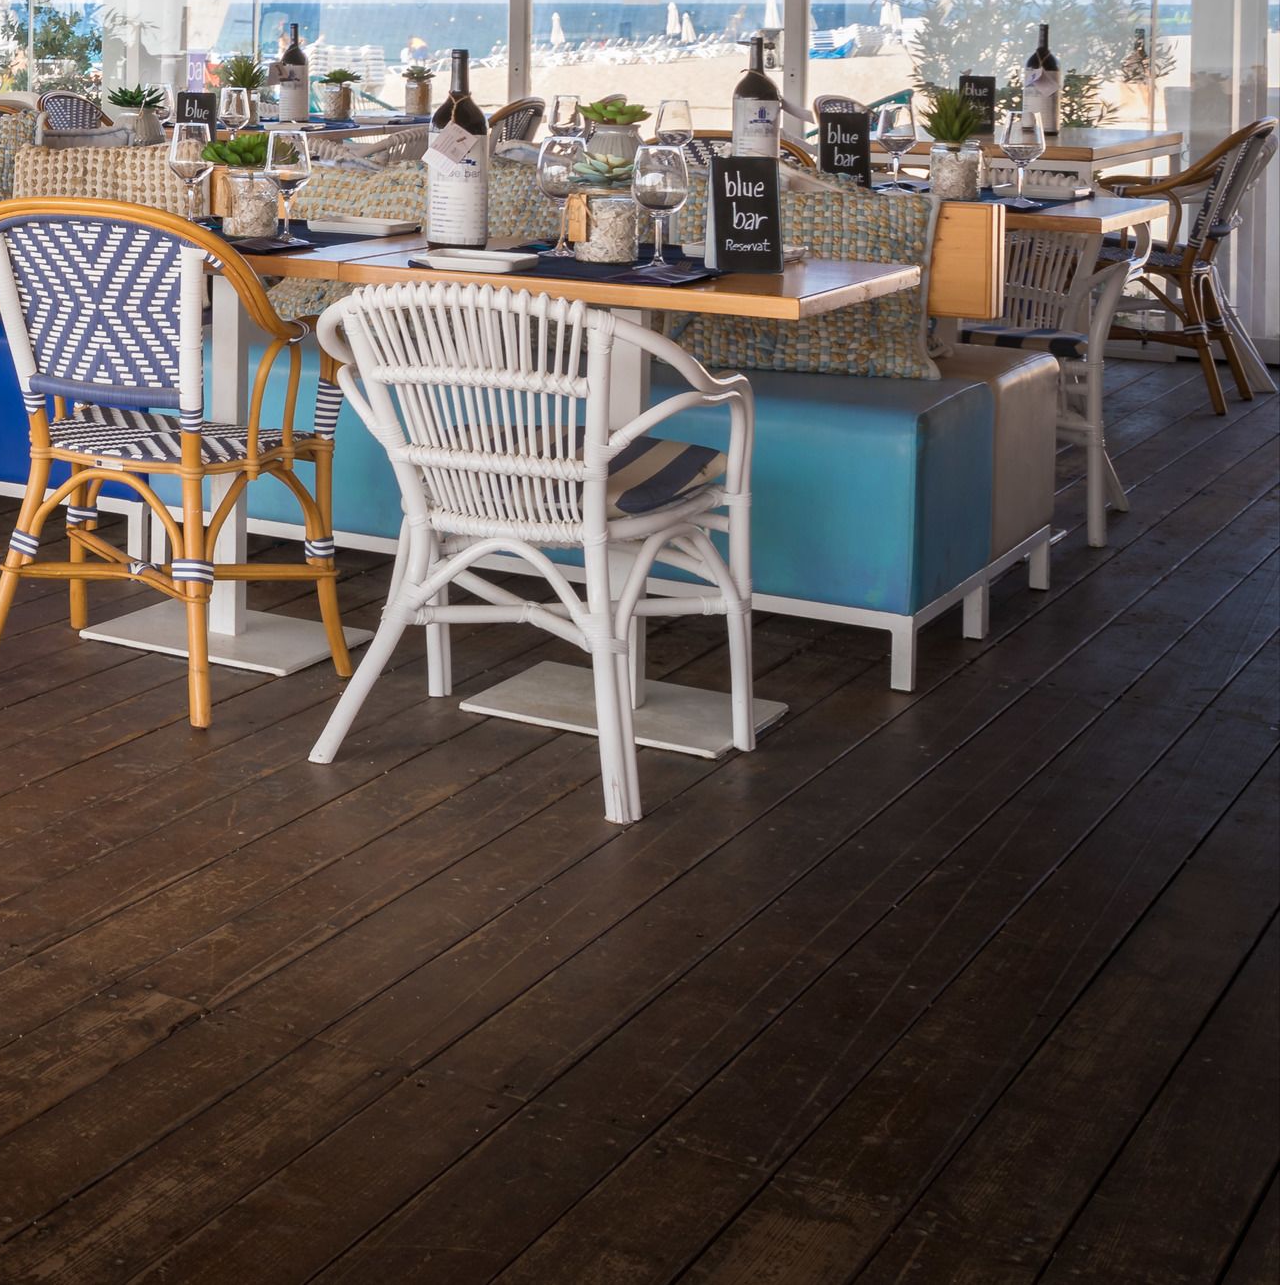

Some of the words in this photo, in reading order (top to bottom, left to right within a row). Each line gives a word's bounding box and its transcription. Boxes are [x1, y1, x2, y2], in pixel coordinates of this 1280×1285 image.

[964, 81, 989, 96] blue
[185, 98, 210, 120] blue
[826, 121, 859, 145] blue
[834, 146, 860, 167] bar
[724, 170, 765, 198] blue
[732, 201, 768, 231] bar
[725, 238, 772, 252] Reservat
